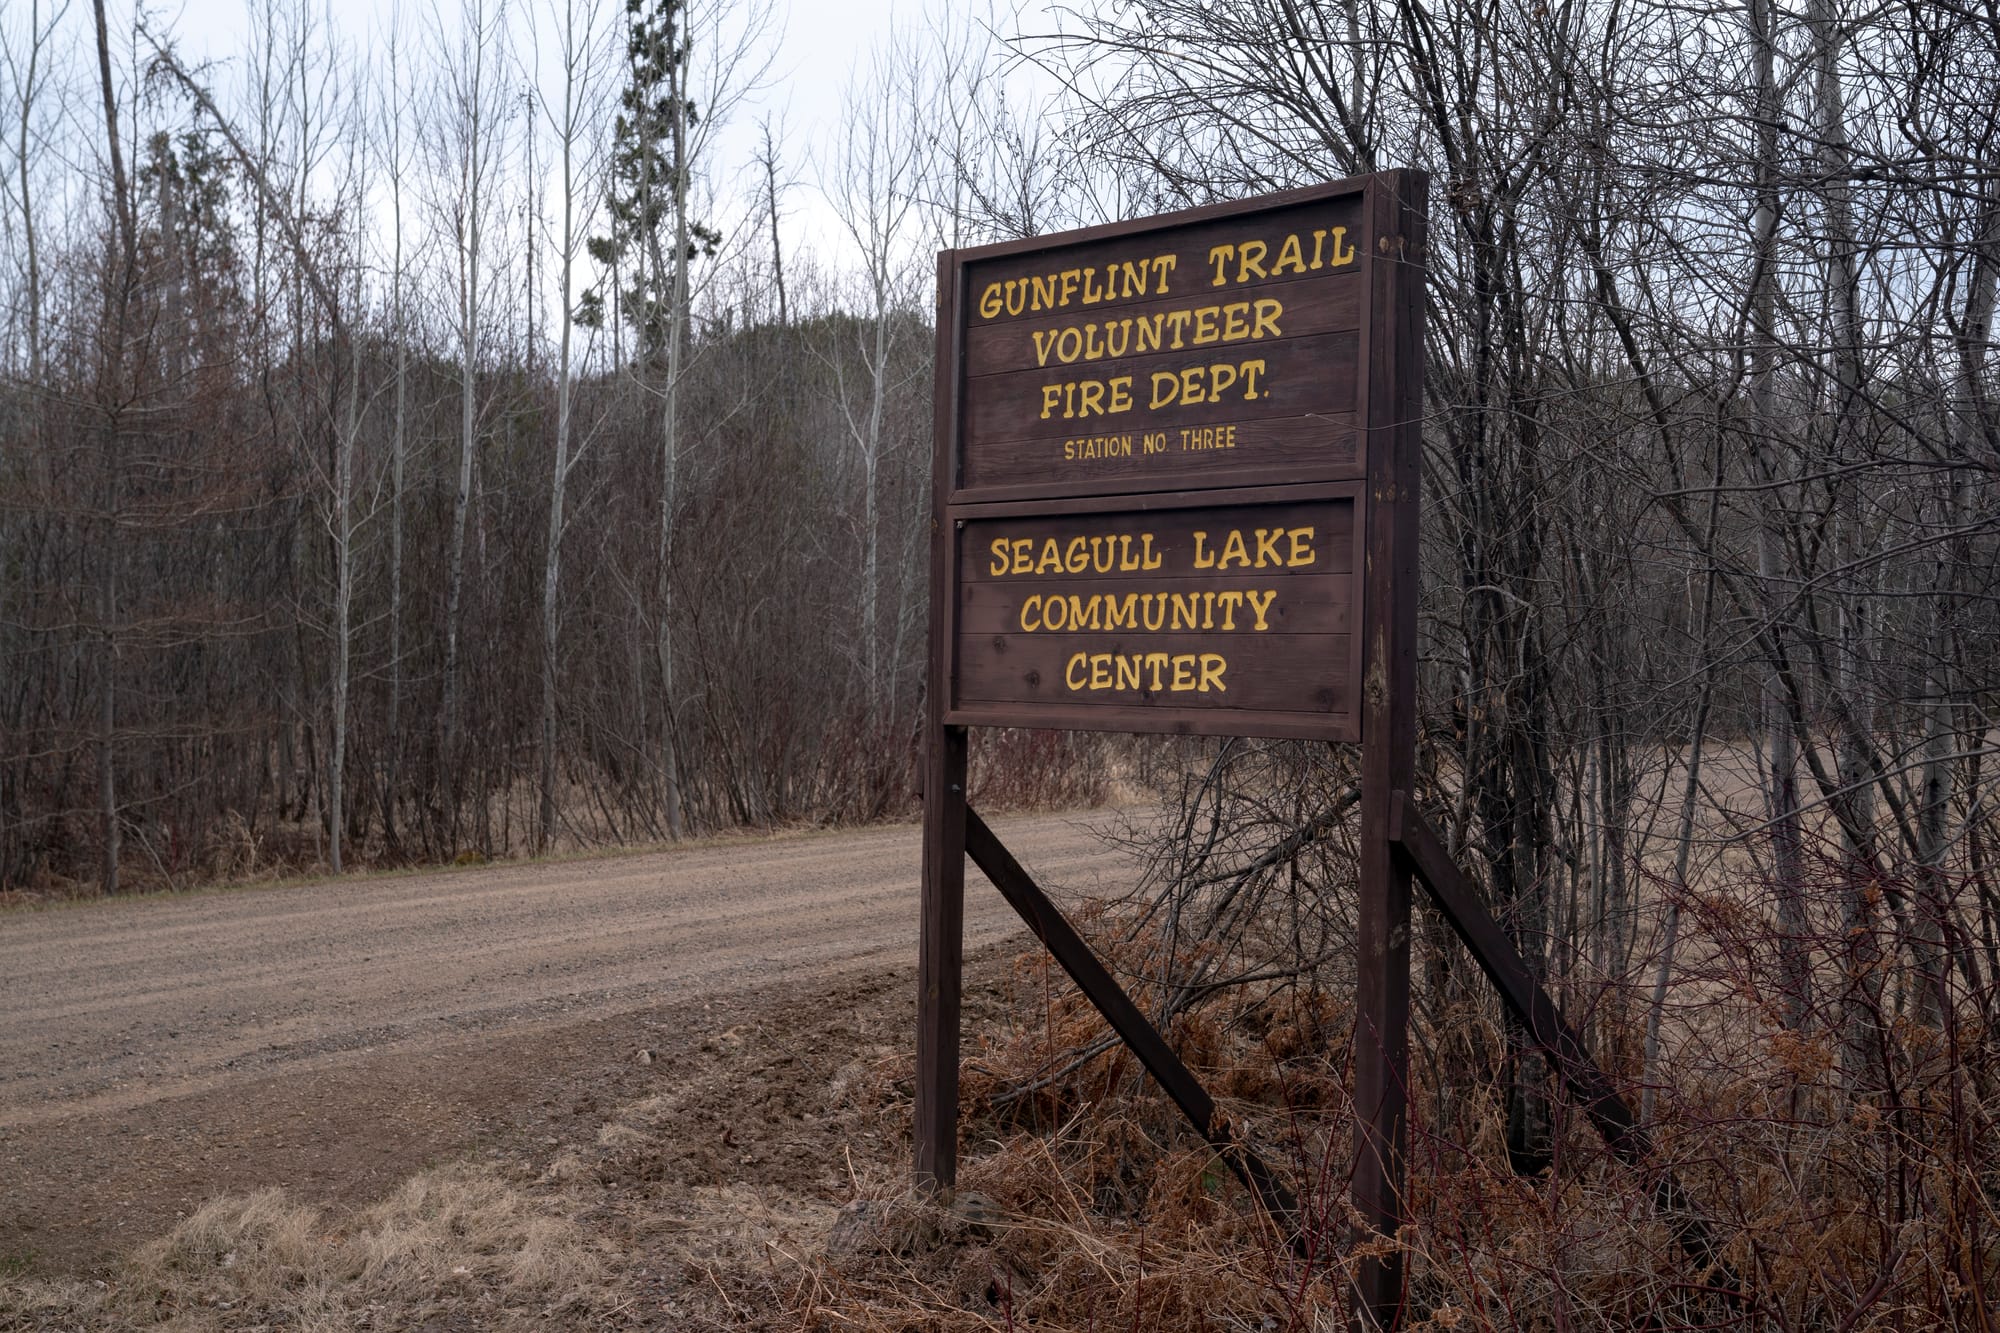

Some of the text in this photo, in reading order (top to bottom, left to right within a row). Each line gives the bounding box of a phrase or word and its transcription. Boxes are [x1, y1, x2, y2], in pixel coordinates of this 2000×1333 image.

[979, 226, 1356, 320] GUNFLINT TRAIL
[1031, 298, 1284, 368] VOLUNTEER
[1039, 359, 1270, 421] FIRE DEPT.
[1064, 433, 1133, 461] STATION
[1180, 425, 1237, 452] THREE
[990, 526, 1316, 578] SEAGULL LAKE
[1020, 589, 1278, 634] COMMUNITY
[1065, 651, 1228, 693] CENTER
